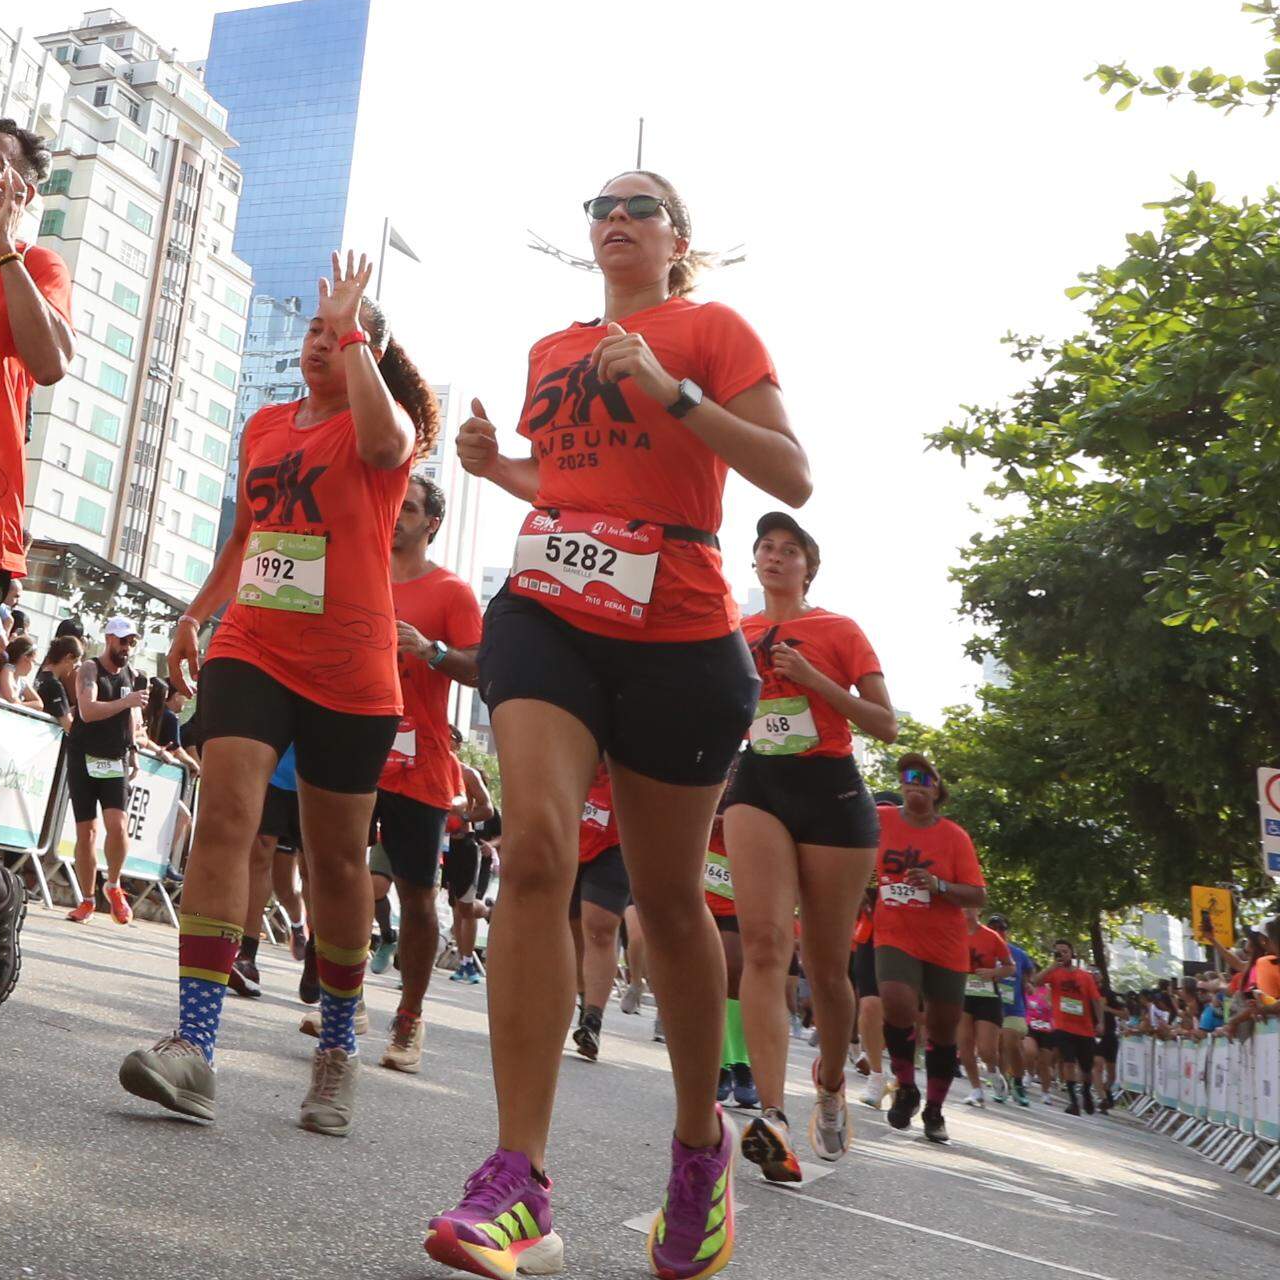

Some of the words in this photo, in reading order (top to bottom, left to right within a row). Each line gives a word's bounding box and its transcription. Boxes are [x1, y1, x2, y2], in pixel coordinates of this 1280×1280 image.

[557, 452, 599, 470] 2025
[545, 535, 618, 577] 5282
[256, 556, 295, 580] 1992
[604, 600, 627, 613] GERAL
[890, 885, 916, 897] 5329
